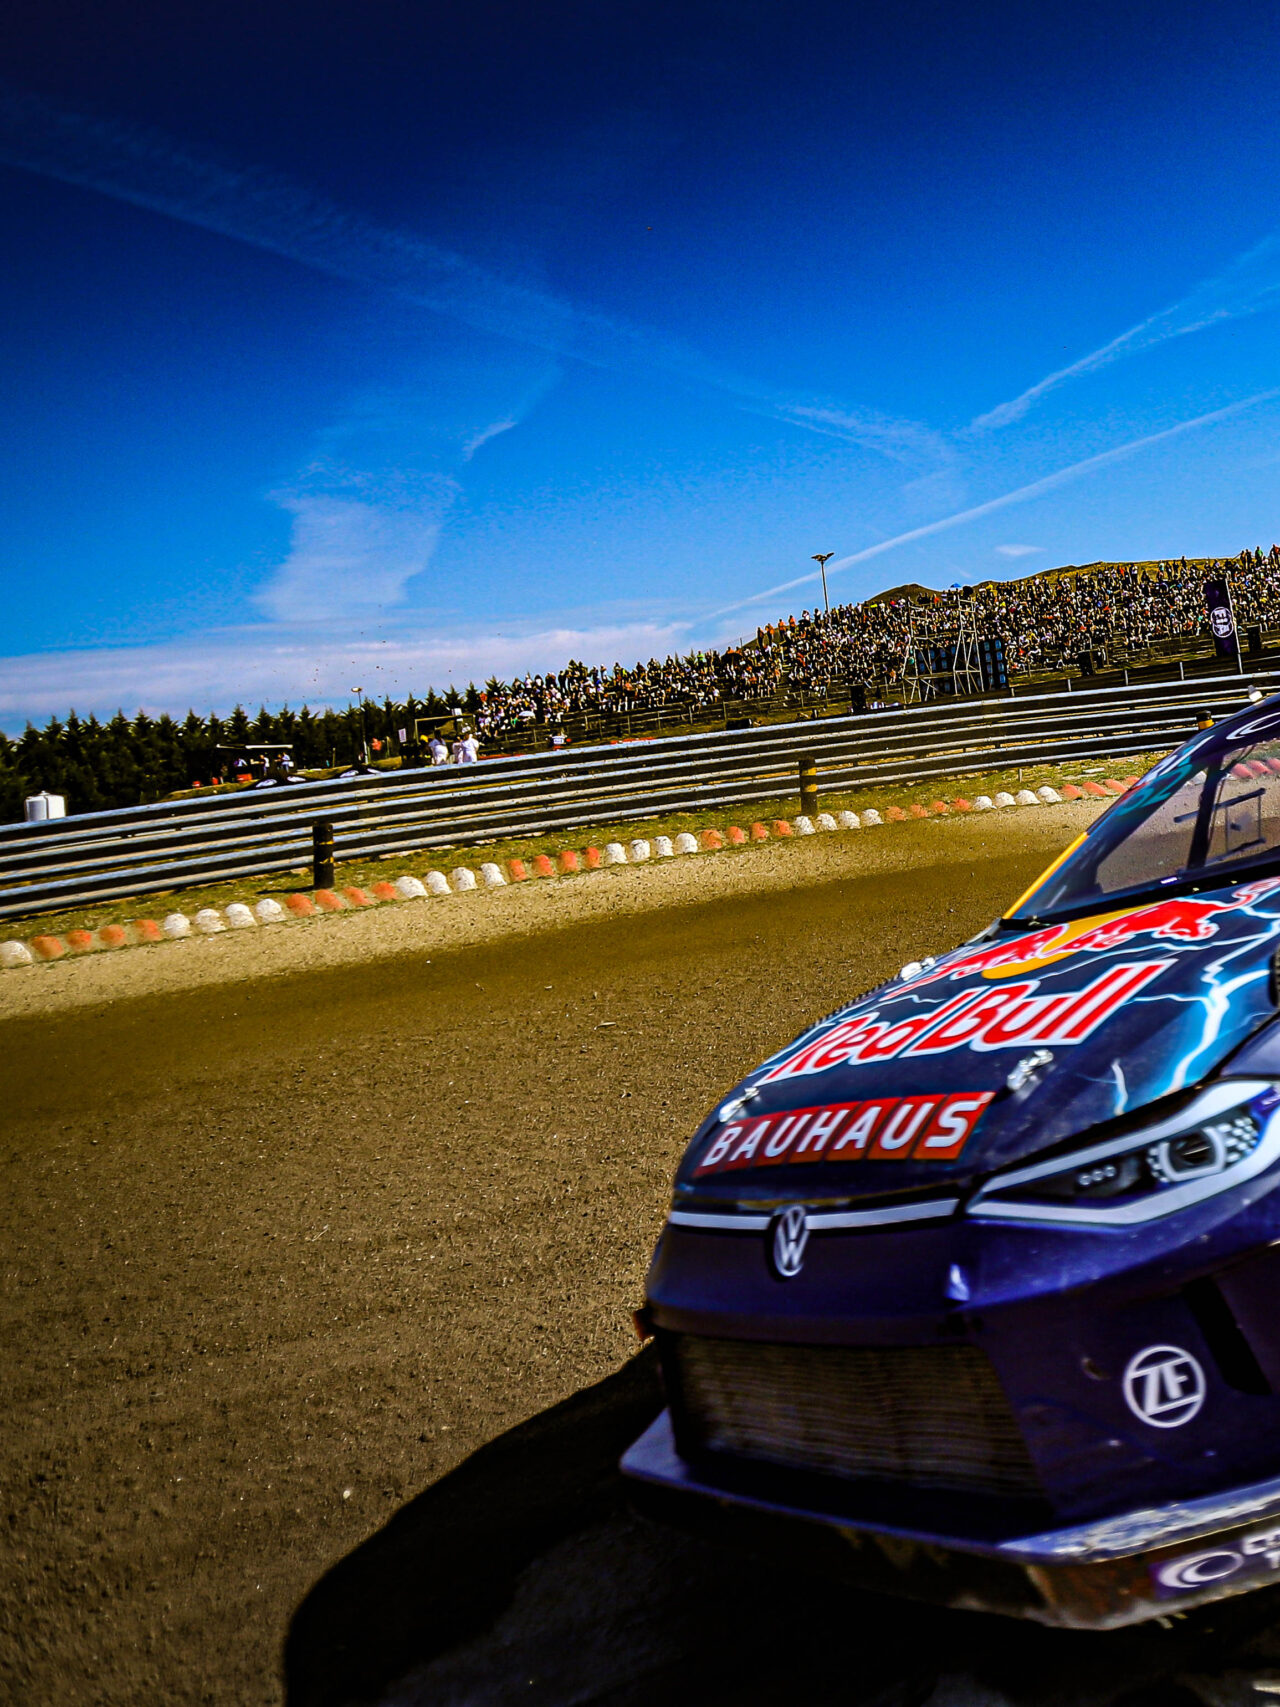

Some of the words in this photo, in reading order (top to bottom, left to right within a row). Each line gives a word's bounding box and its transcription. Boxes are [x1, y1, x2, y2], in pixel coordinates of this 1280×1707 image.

[754, 986, 990, 1087] Red
[899, 959, 1178, 1058] Bull
[702, 1101, 984, 1167] BAUHAUS
[1129, 1355, 1201, 1417] ZF
